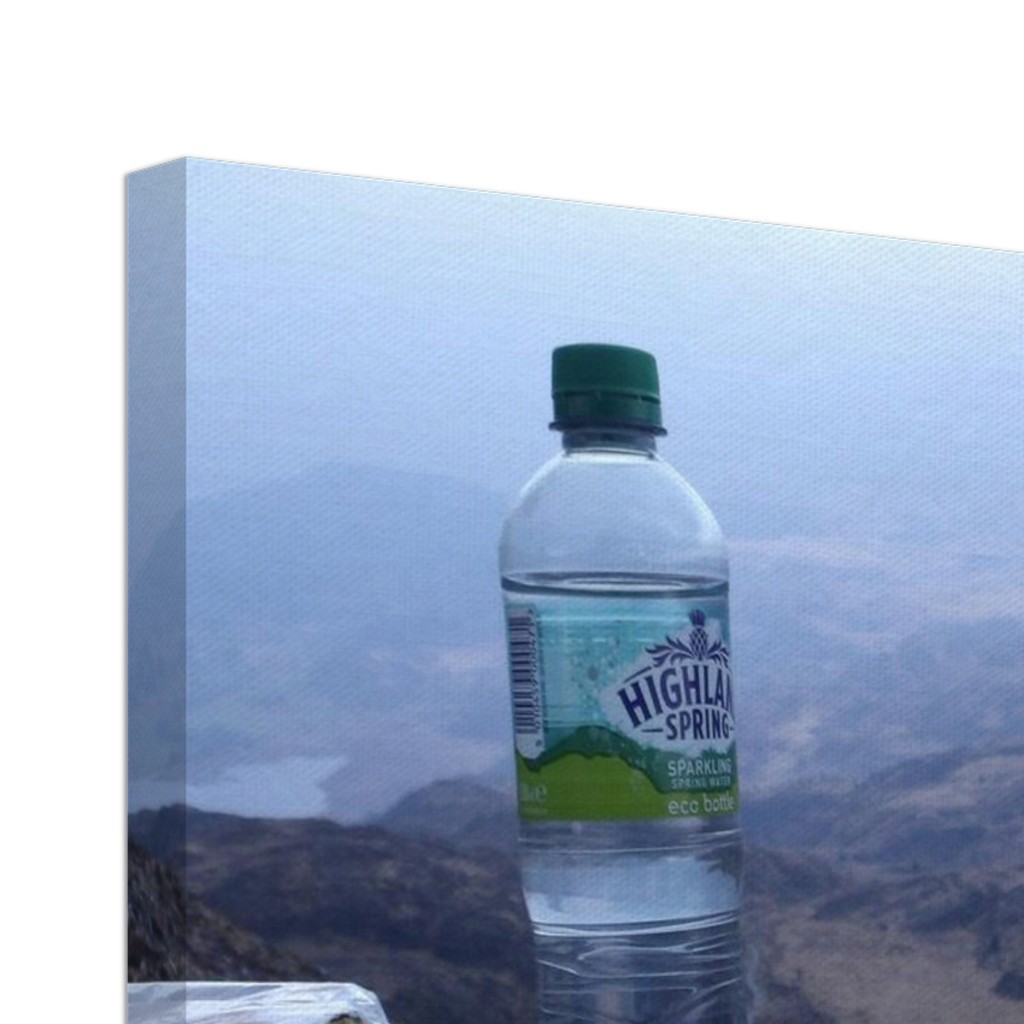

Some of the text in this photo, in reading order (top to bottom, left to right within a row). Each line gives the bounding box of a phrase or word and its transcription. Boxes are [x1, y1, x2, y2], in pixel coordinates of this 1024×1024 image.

[666, 709, 730, 741] SPRING
[668, 758, 732, 777] SPARKLING
[667, 791, 735, 815] eco bottle
